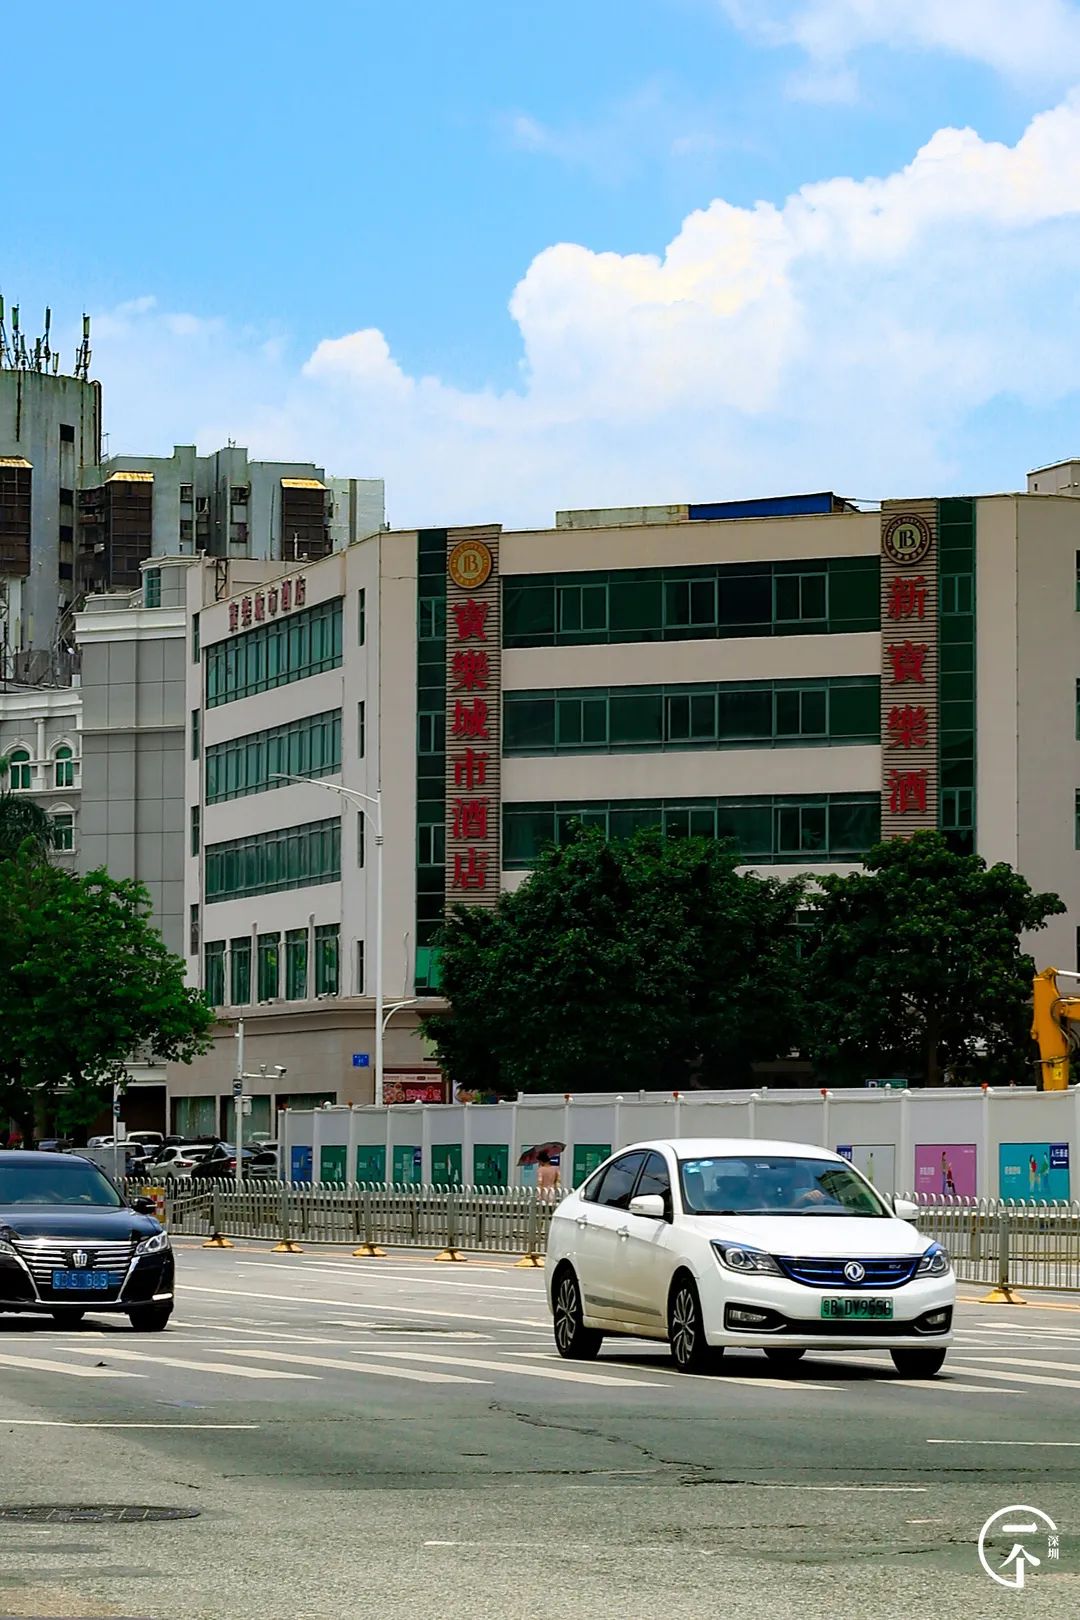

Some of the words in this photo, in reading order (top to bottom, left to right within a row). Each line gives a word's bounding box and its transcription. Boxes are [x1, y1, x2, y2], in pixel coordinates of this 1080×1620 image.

[450, 598, 490, 890] 寶樂城市酒店
[887, 575, 929, 842] 新寶樂酒
